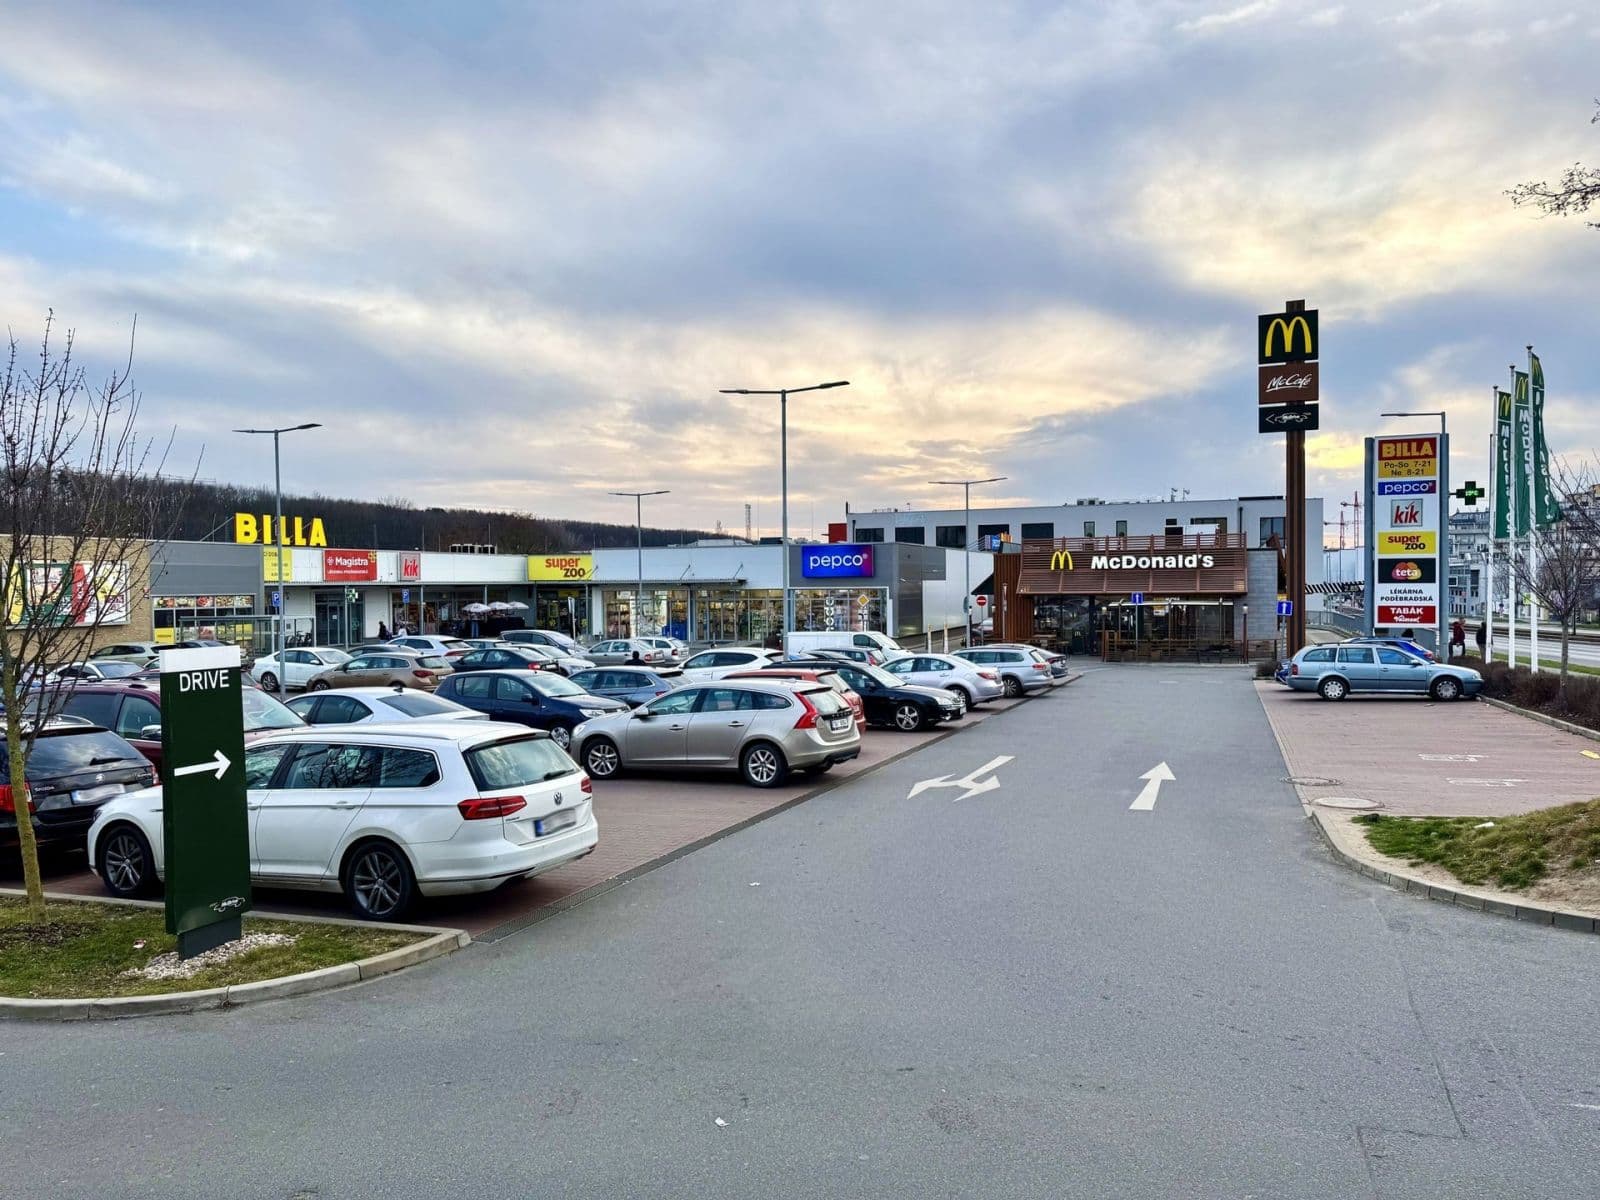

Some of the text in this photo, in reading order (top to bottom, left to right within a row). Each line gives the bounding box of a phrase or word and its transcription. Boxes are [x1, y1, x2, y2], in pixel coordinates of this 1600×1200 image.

[1381, 441, 1433, 458] BILLA
[1414, 460, 1431, 468] 7-21
[1384, 482, 1430, 494] pepco
[234, 512, 328, 547] BILLA
[1387, 535, 1421, 545] super
[335, 556, 369, 568] Magistra
[403, 558, 419, 577] kik
[545, 558, 581, 570] super
[809, 554, 864, 570] pepco
[1091, 554, 1215, 570] McDonald's
[563, 567, 586, 578] zoo
[1395, 566, 1418, 577] teta
[1389, 587, 1424, 595] LÉKÁRNA
[1390, 606, 1424, 615] TABÁK
[179, 669, 230, 693] DRIVE
